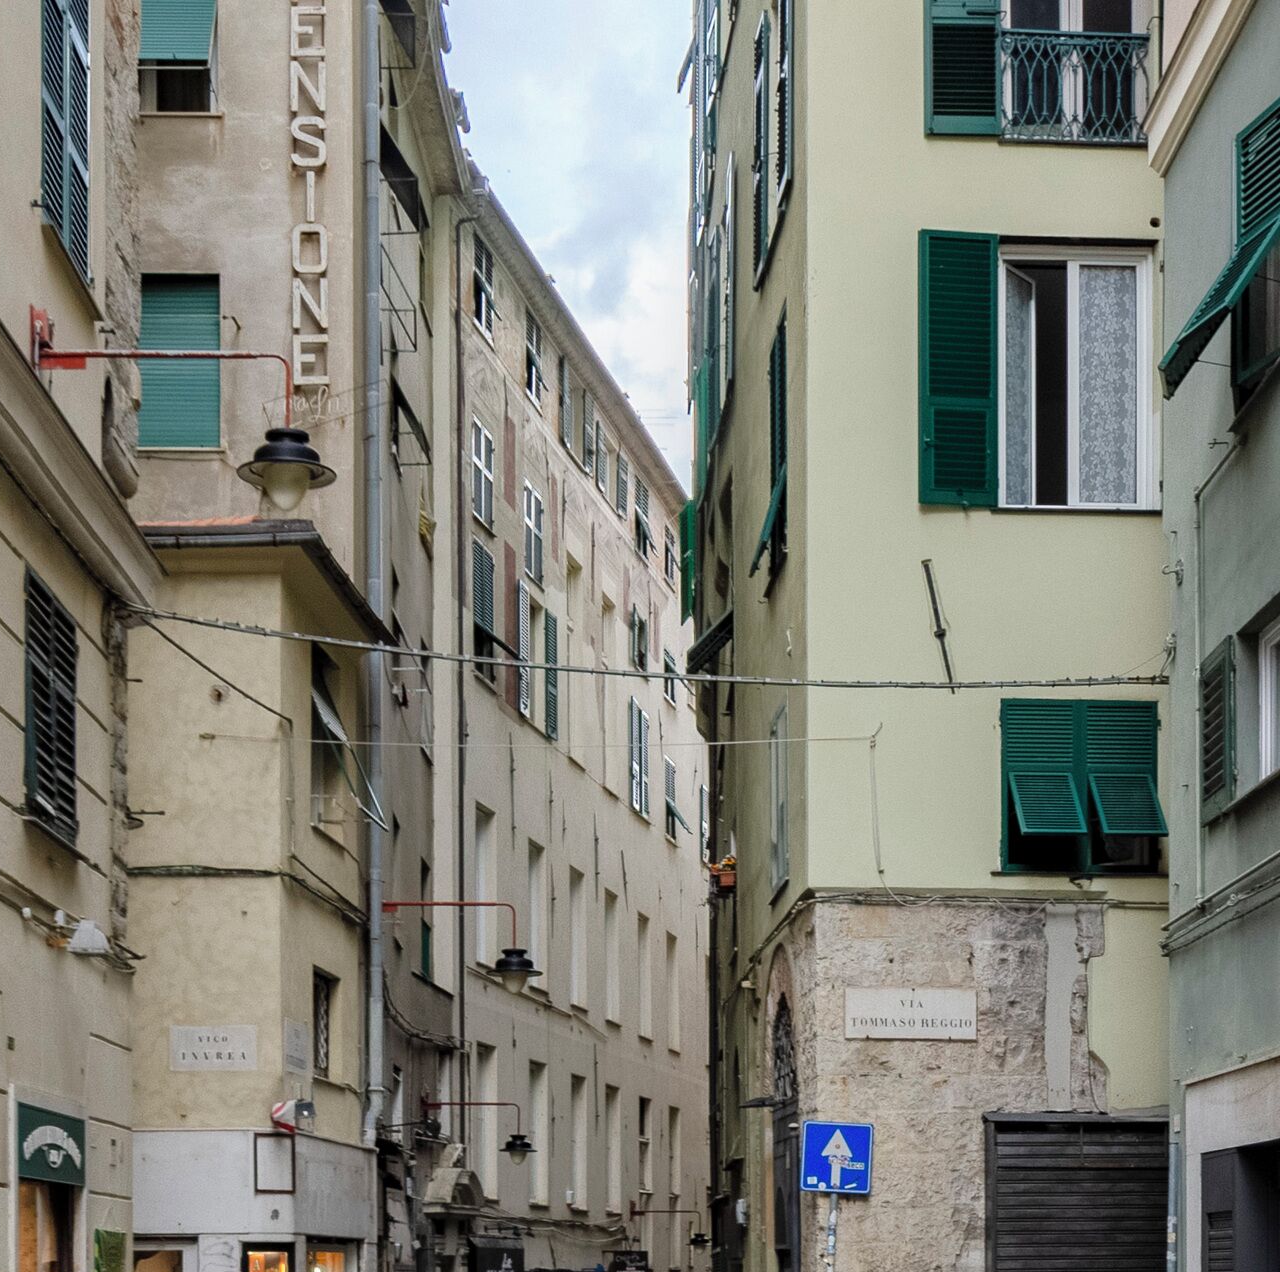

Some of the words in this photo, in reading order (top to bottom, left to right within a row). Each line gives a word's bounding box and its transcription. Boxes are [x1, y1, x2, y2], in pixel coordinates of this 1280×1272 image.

[899, 999, 924, 1008] VIA
[850, 1017, 916, 1028] TOMMASO
[921, 1018, 973, 1029] REGGIO
[197, 1035, 229, 1043] VICO
[181, 1051, 247, 1061] INVREA
